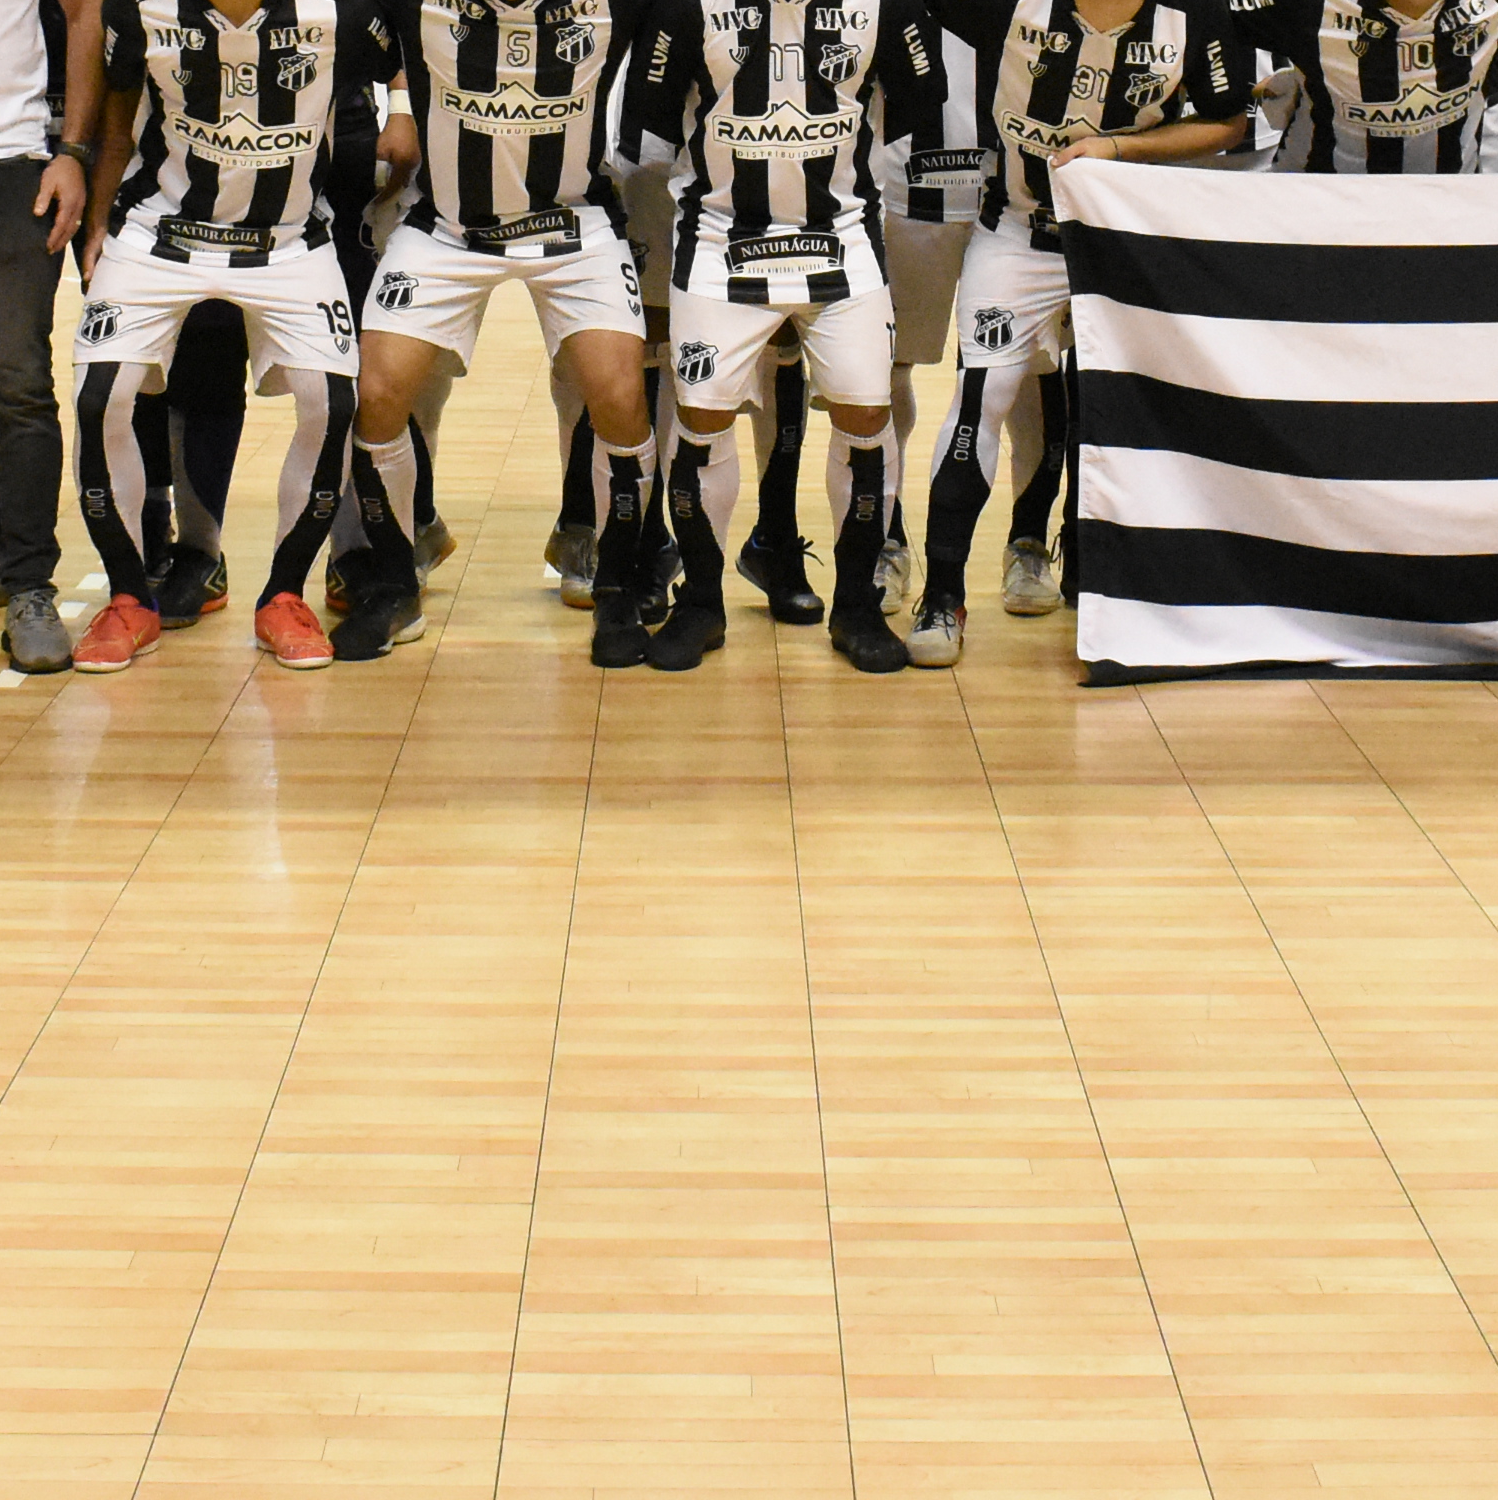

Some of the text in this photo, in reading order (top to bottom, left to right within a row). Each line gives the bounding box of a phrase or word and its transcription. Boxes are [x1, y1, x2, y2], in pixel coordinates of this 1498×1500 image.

[647, 30, 673, 84] ILUMI
[903, 23, 931, 76] ILUMI
[1398, 40, 1435, 73] 10
[219, 62, 259, 99] 19
[1206, 40, 1230, 94] ILUMI
[444, 93, 585, 121] RAMACON
[1348, 81, 1482, 124] RAMACON
[174, 117, 312, 152] RAMACON
[464, 120, 564, 135] DISTRIBUIDORA
[717, 117, 854, 142] RAMACON
[194, 148, 289, 167] DISTRIBUIDORA
[737, 147, 835, 161] DISTRIBUIDORA
[170, 223, 261, 244] NATURÁGUA
[740, 236, 830, 258] NATURÁGUA
[317, 299, 353, 336] 19
